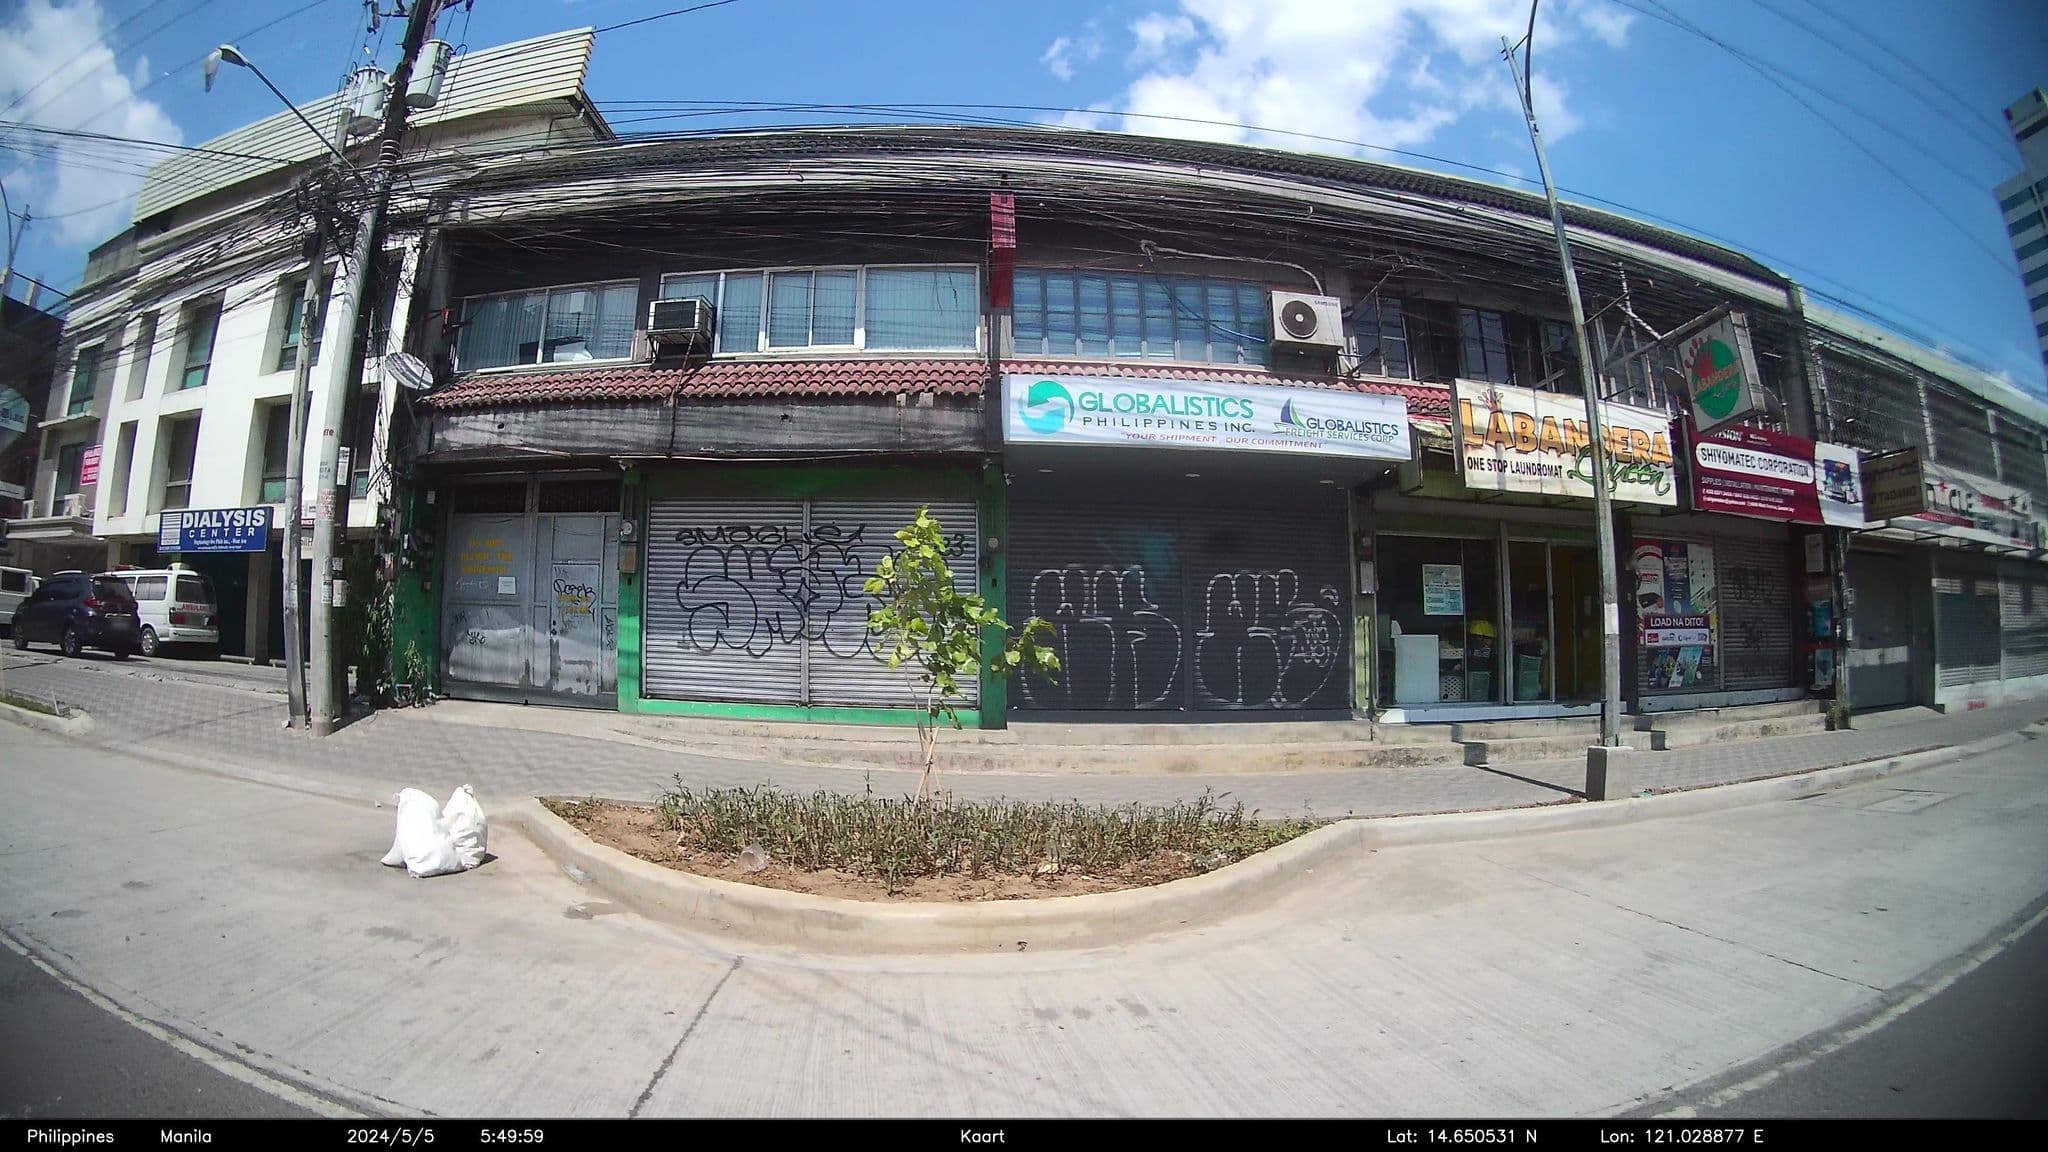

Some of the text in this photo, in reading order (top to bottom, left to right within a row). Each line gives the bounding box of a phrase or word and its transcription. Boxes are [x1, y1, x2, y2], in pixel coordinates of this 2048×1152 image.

[1078, 391, 1254, 419] GLOBALISTICS
[1083, 416, 1256, 433] PHILIPPINES INC.
[1306, 417, 1399, 436] GLOBALISTICS
[1159, 433, 1217, 443] SHIPMENT
[1225, 437, 1250, 445] OUR
[1285, 427, 1394, 443] FREIGHT SERVICES CORP
[1467, 456, 1563, 479] ONE STOP LAUNDROMAT
[1700, 447, 1809, 478] SHIYOMATEC CORPORATION
[182, 509, 266, 529] DIALYSIS
[188, 527, 256, 538] CENTER
[1650, 616, 1704, 627] LOAD NA DITO!
